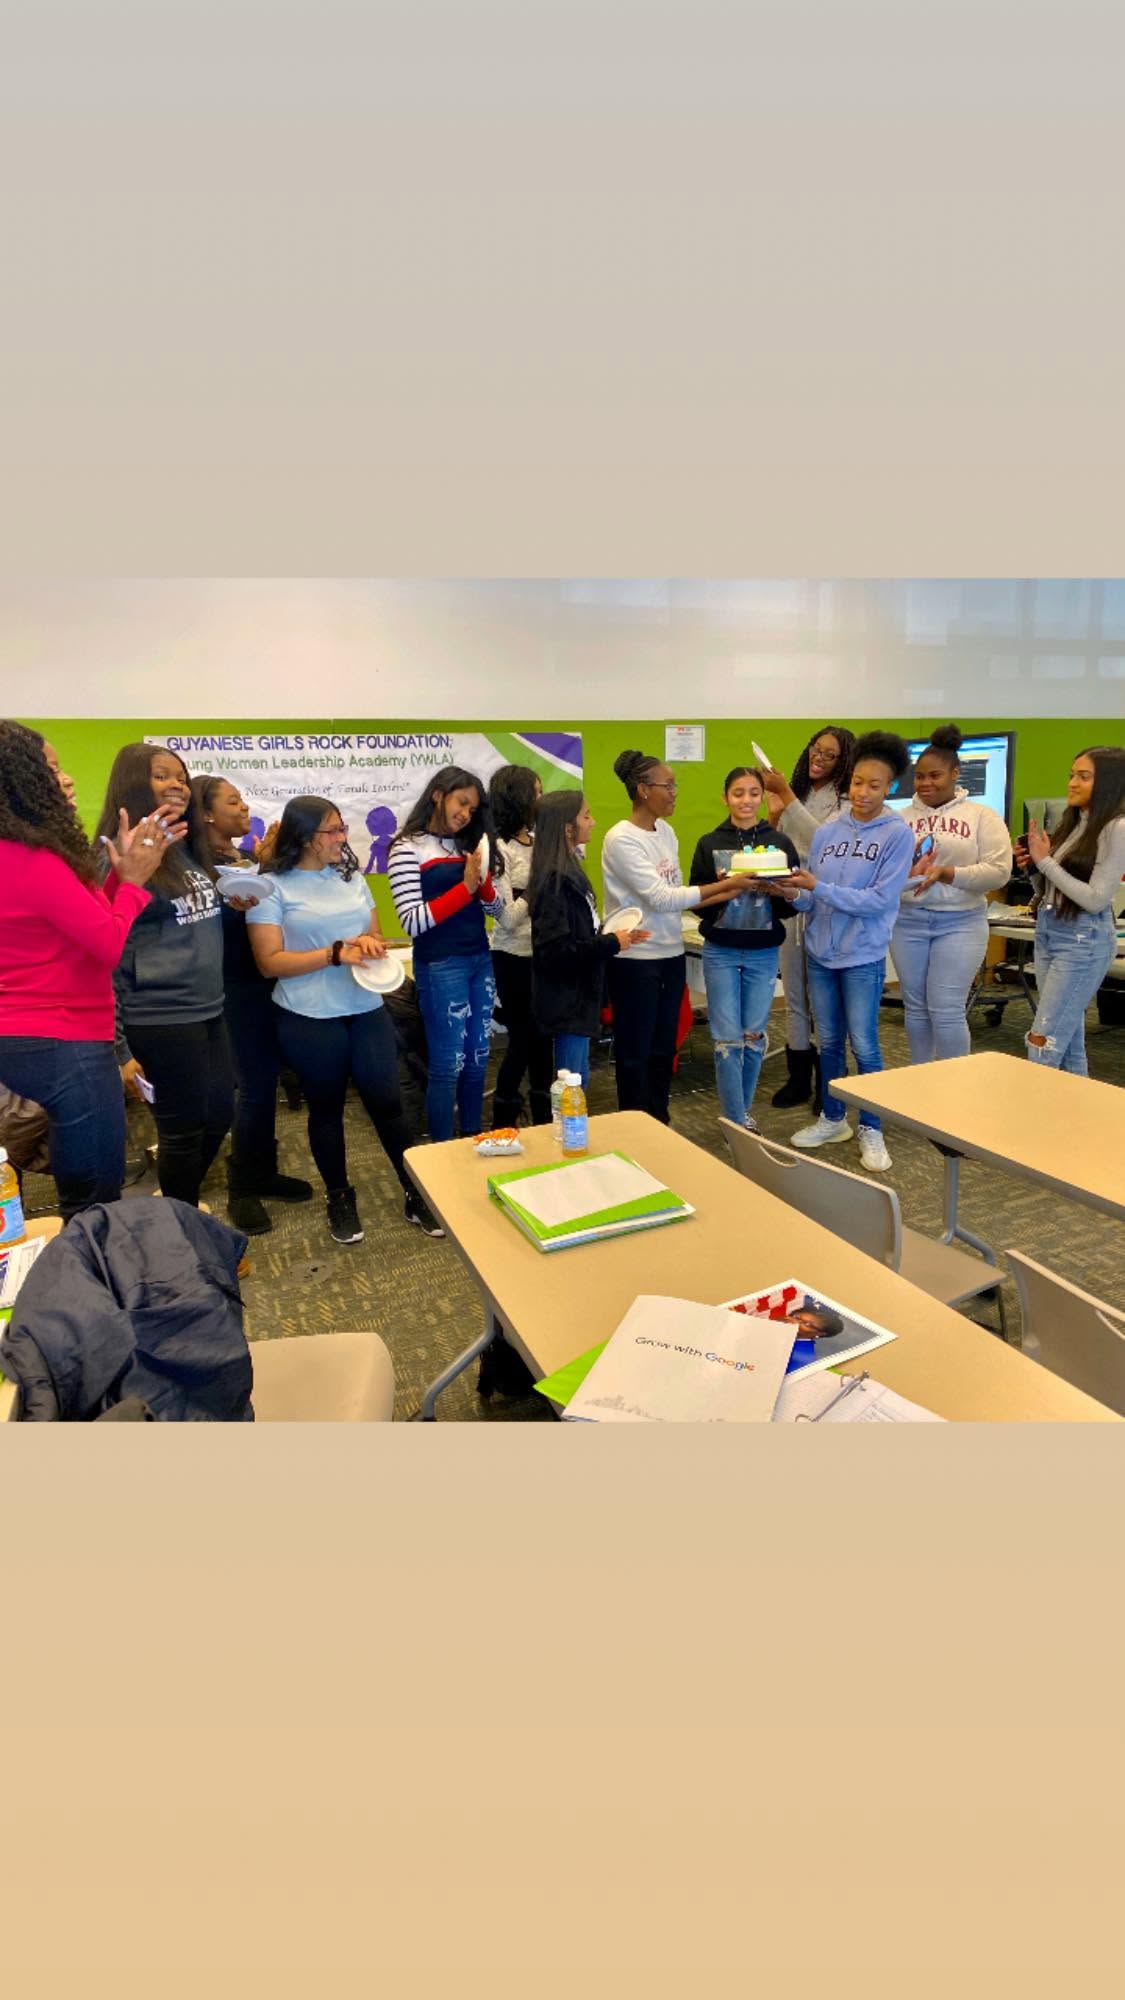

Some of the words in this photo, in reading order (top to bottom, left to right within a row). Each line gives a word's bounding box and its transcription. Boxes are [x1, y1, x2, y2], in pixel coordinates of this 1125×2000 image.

[166, 736, 252, 751] GUYANESE
[258, 735, 303, 750] GIRLS
[308, 735, 352, 749] ROCK
[187, 760, 213, 773] ung
[215, 757, 269, 770] Women
[272, 754, 344, 770] Leadership
[349, 755, 407, 769] Academy
[410, 752, 455, 766] (YWLA)
[908, 815, 971, 838] RVARD
[819, 839, 880, 864] POLO
[635, 1336, 670, 1349] Grow
[674, 1344, 703, 1357] with
[705, 1351, 756, 1370] Google
